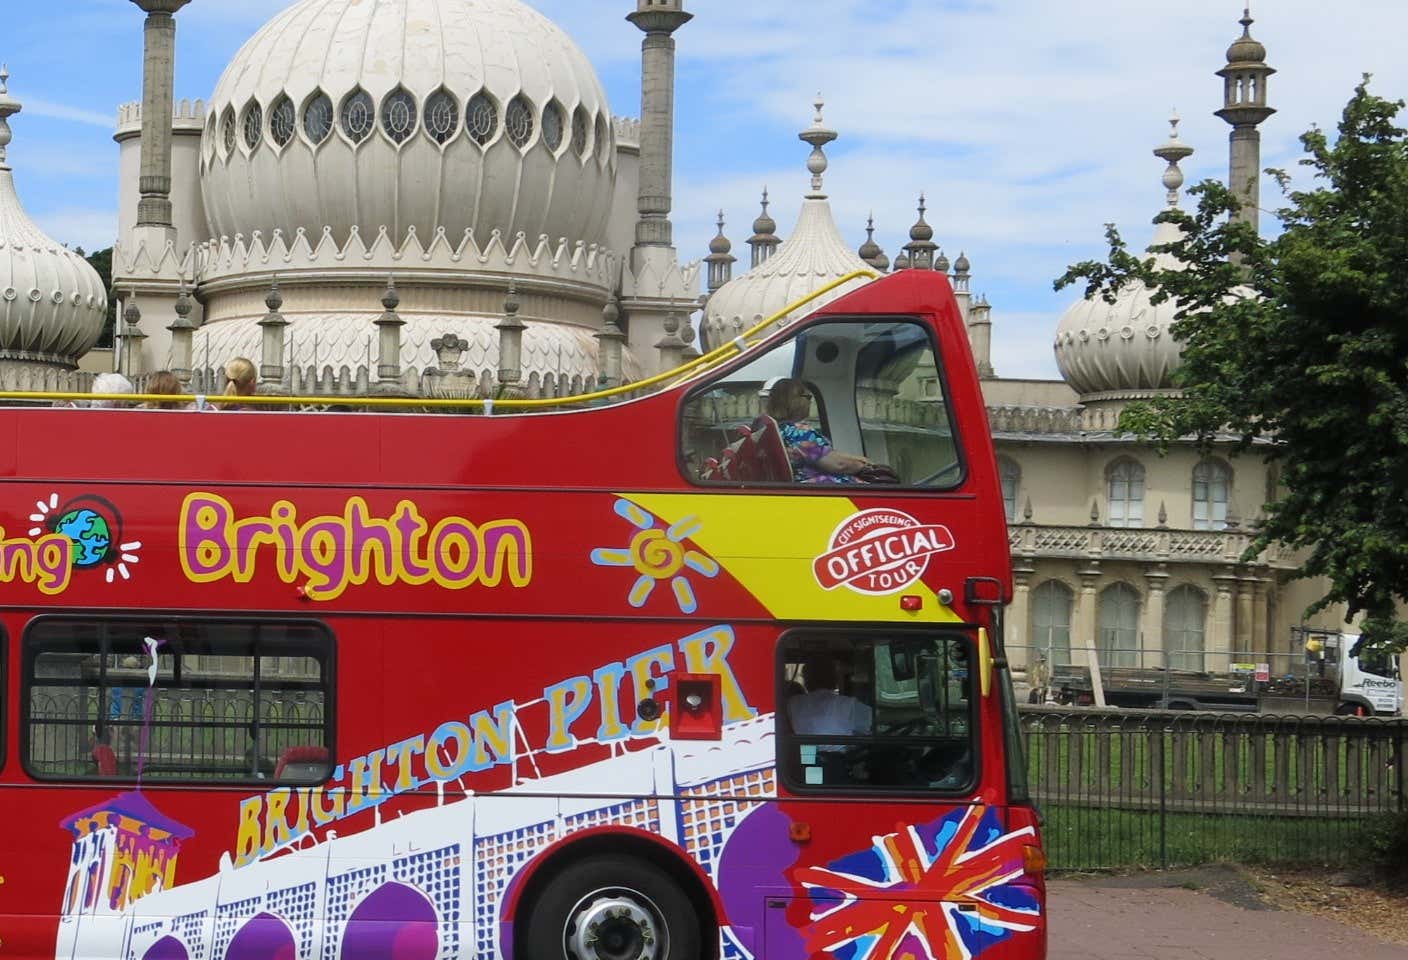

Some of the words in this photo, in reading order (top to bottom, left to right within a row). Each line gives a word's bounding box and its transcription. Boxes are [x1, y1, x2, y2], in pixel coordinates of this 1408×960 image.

[179, 492, 532, 600] Brighton
[827, 528, 947, 580] OFFICIAL
[838, 525, 855, 545] CITY
[853, 514, 912, 532] SIGHTSEEING
[868, 560, 921, 588] TOUR
[233, 699, 515, 871] BRIGHTON
[543, 624, 759, 752] PIER
